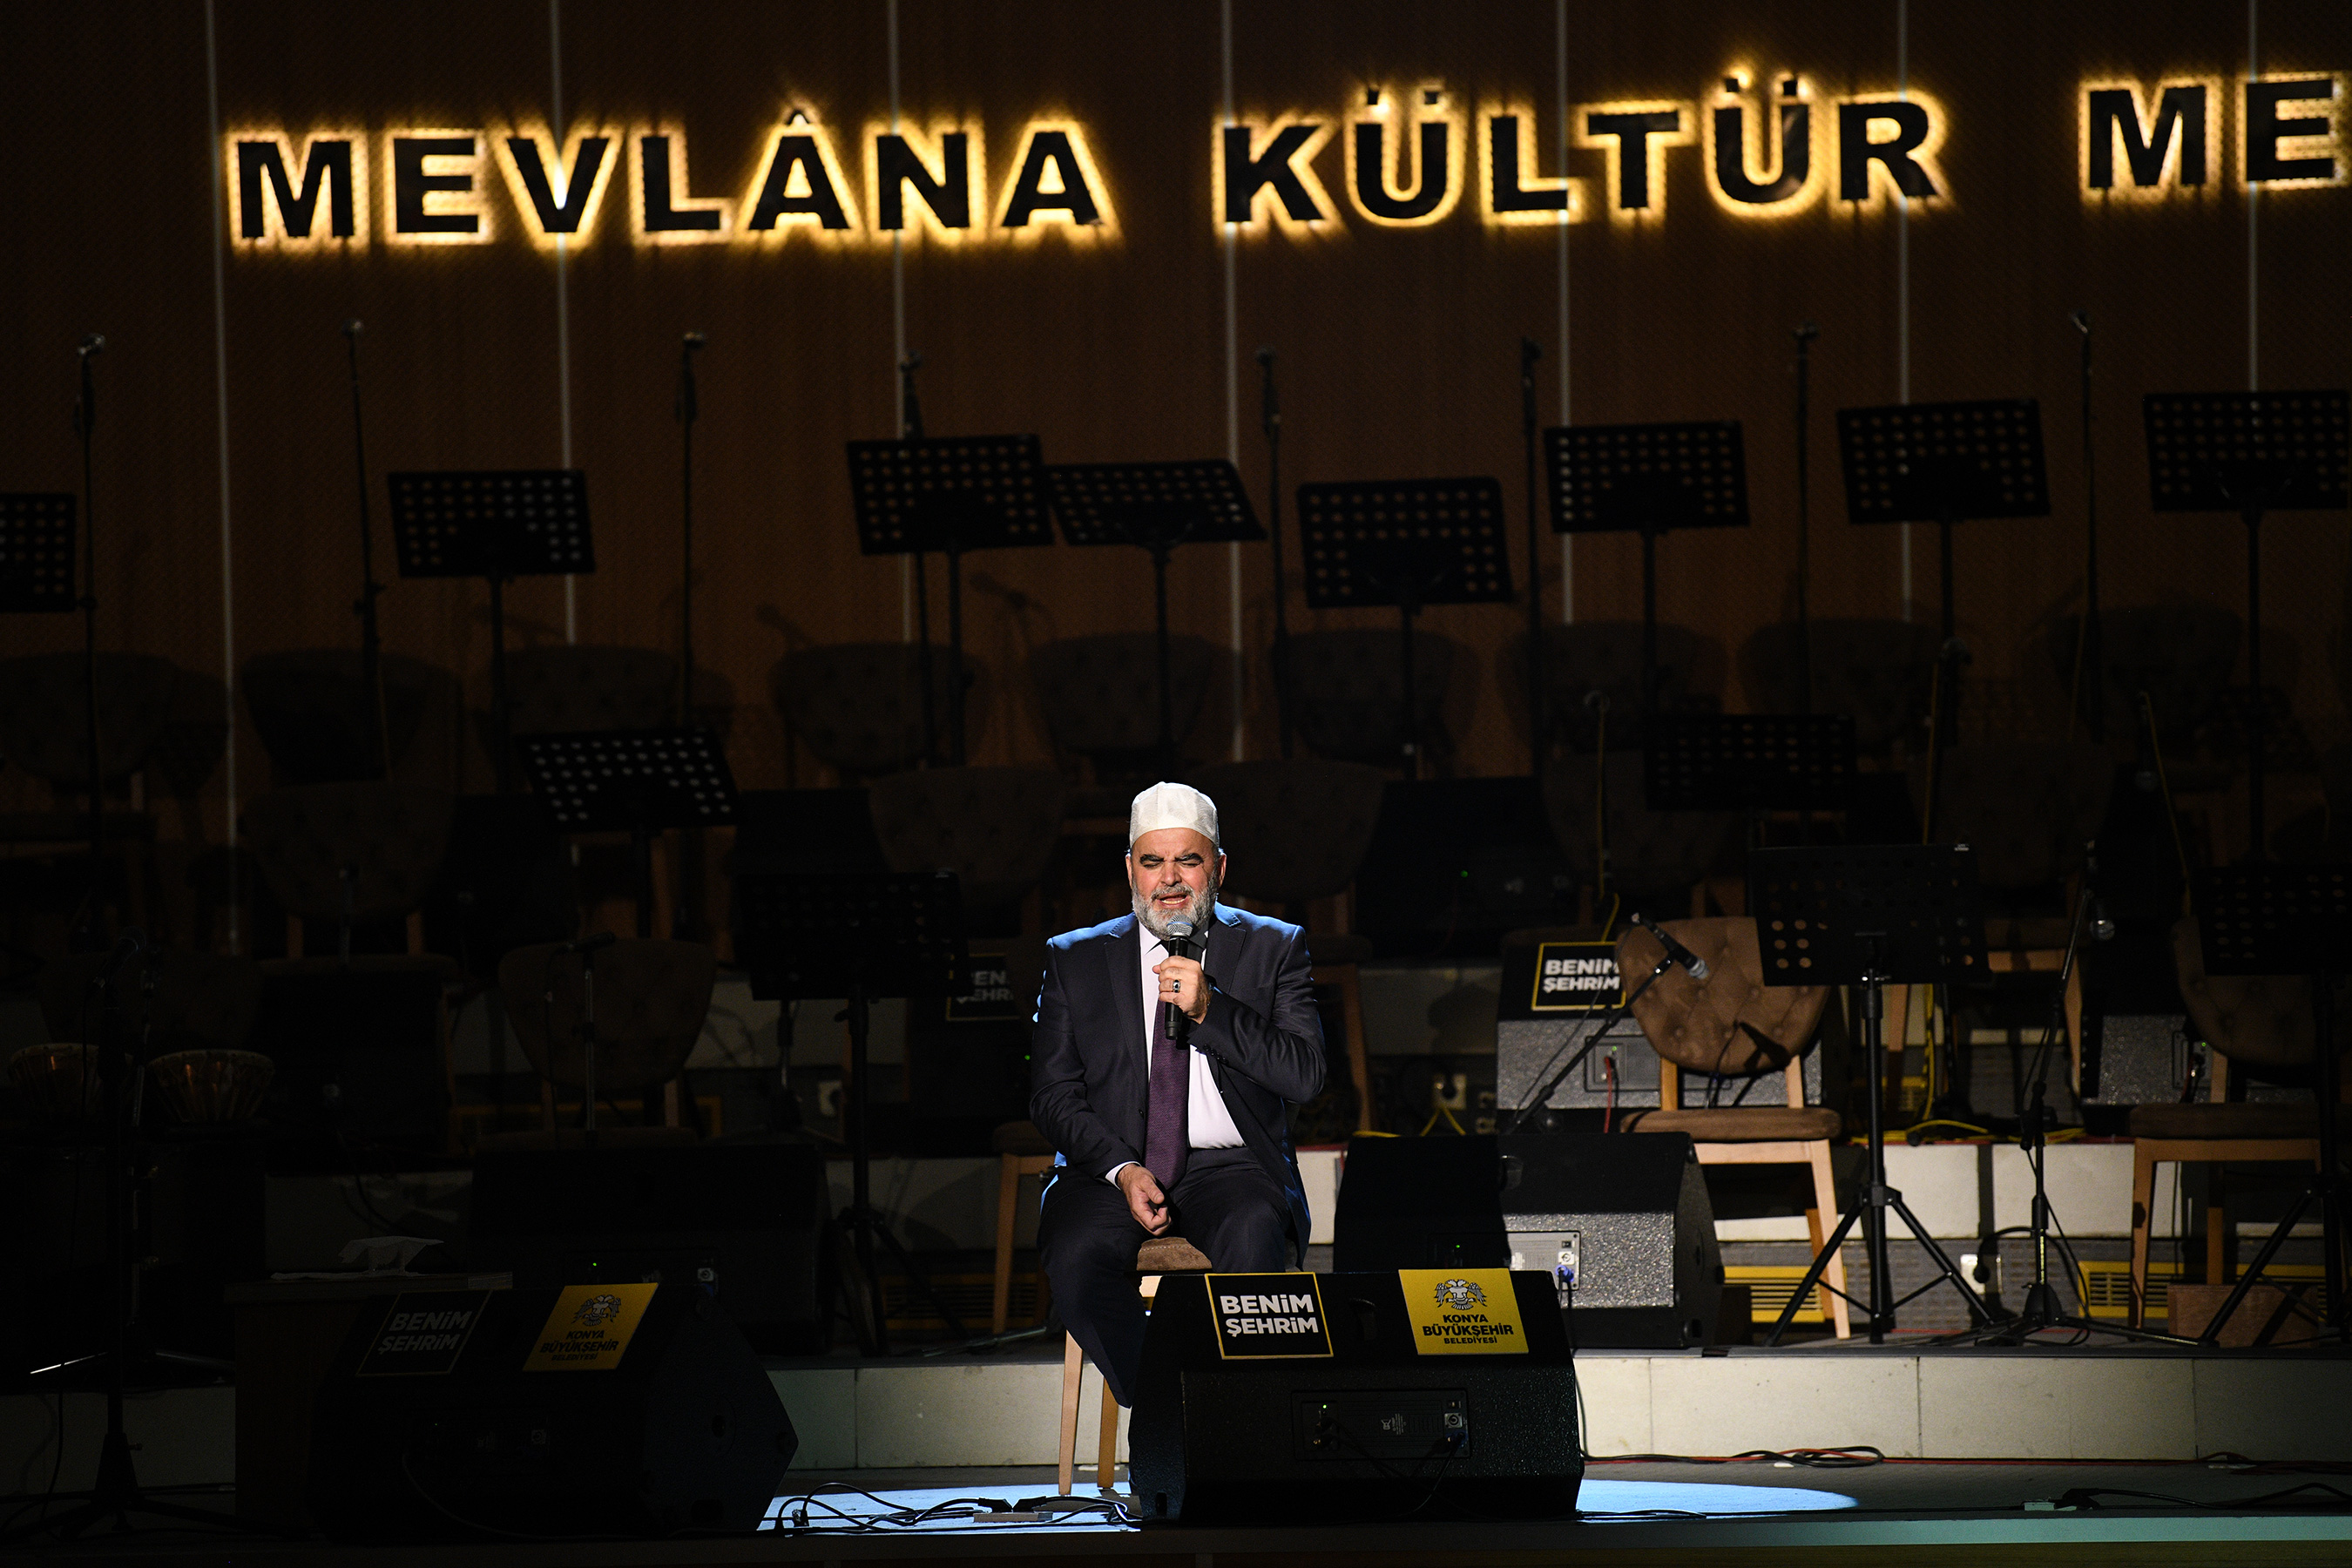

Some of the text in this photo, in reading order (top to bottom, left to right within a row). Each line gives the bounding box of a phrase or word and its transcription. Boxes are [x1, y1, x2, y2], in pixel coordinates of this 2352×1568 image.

[236, 78, 2335, 238] MEVLÂNA KÜLTÜR ME
[1443, 1315, 1489, 1323] KONYA
[565, 1330, 605, 1340] KONYA
[1422, 1322, 1514, 1337] BÜYÜKŞEHİR
[1443, 1335, 1498, 1344] BELEDİYESİ
[540, 1339, 619, 1353] BÜYÜKŞEHİR
